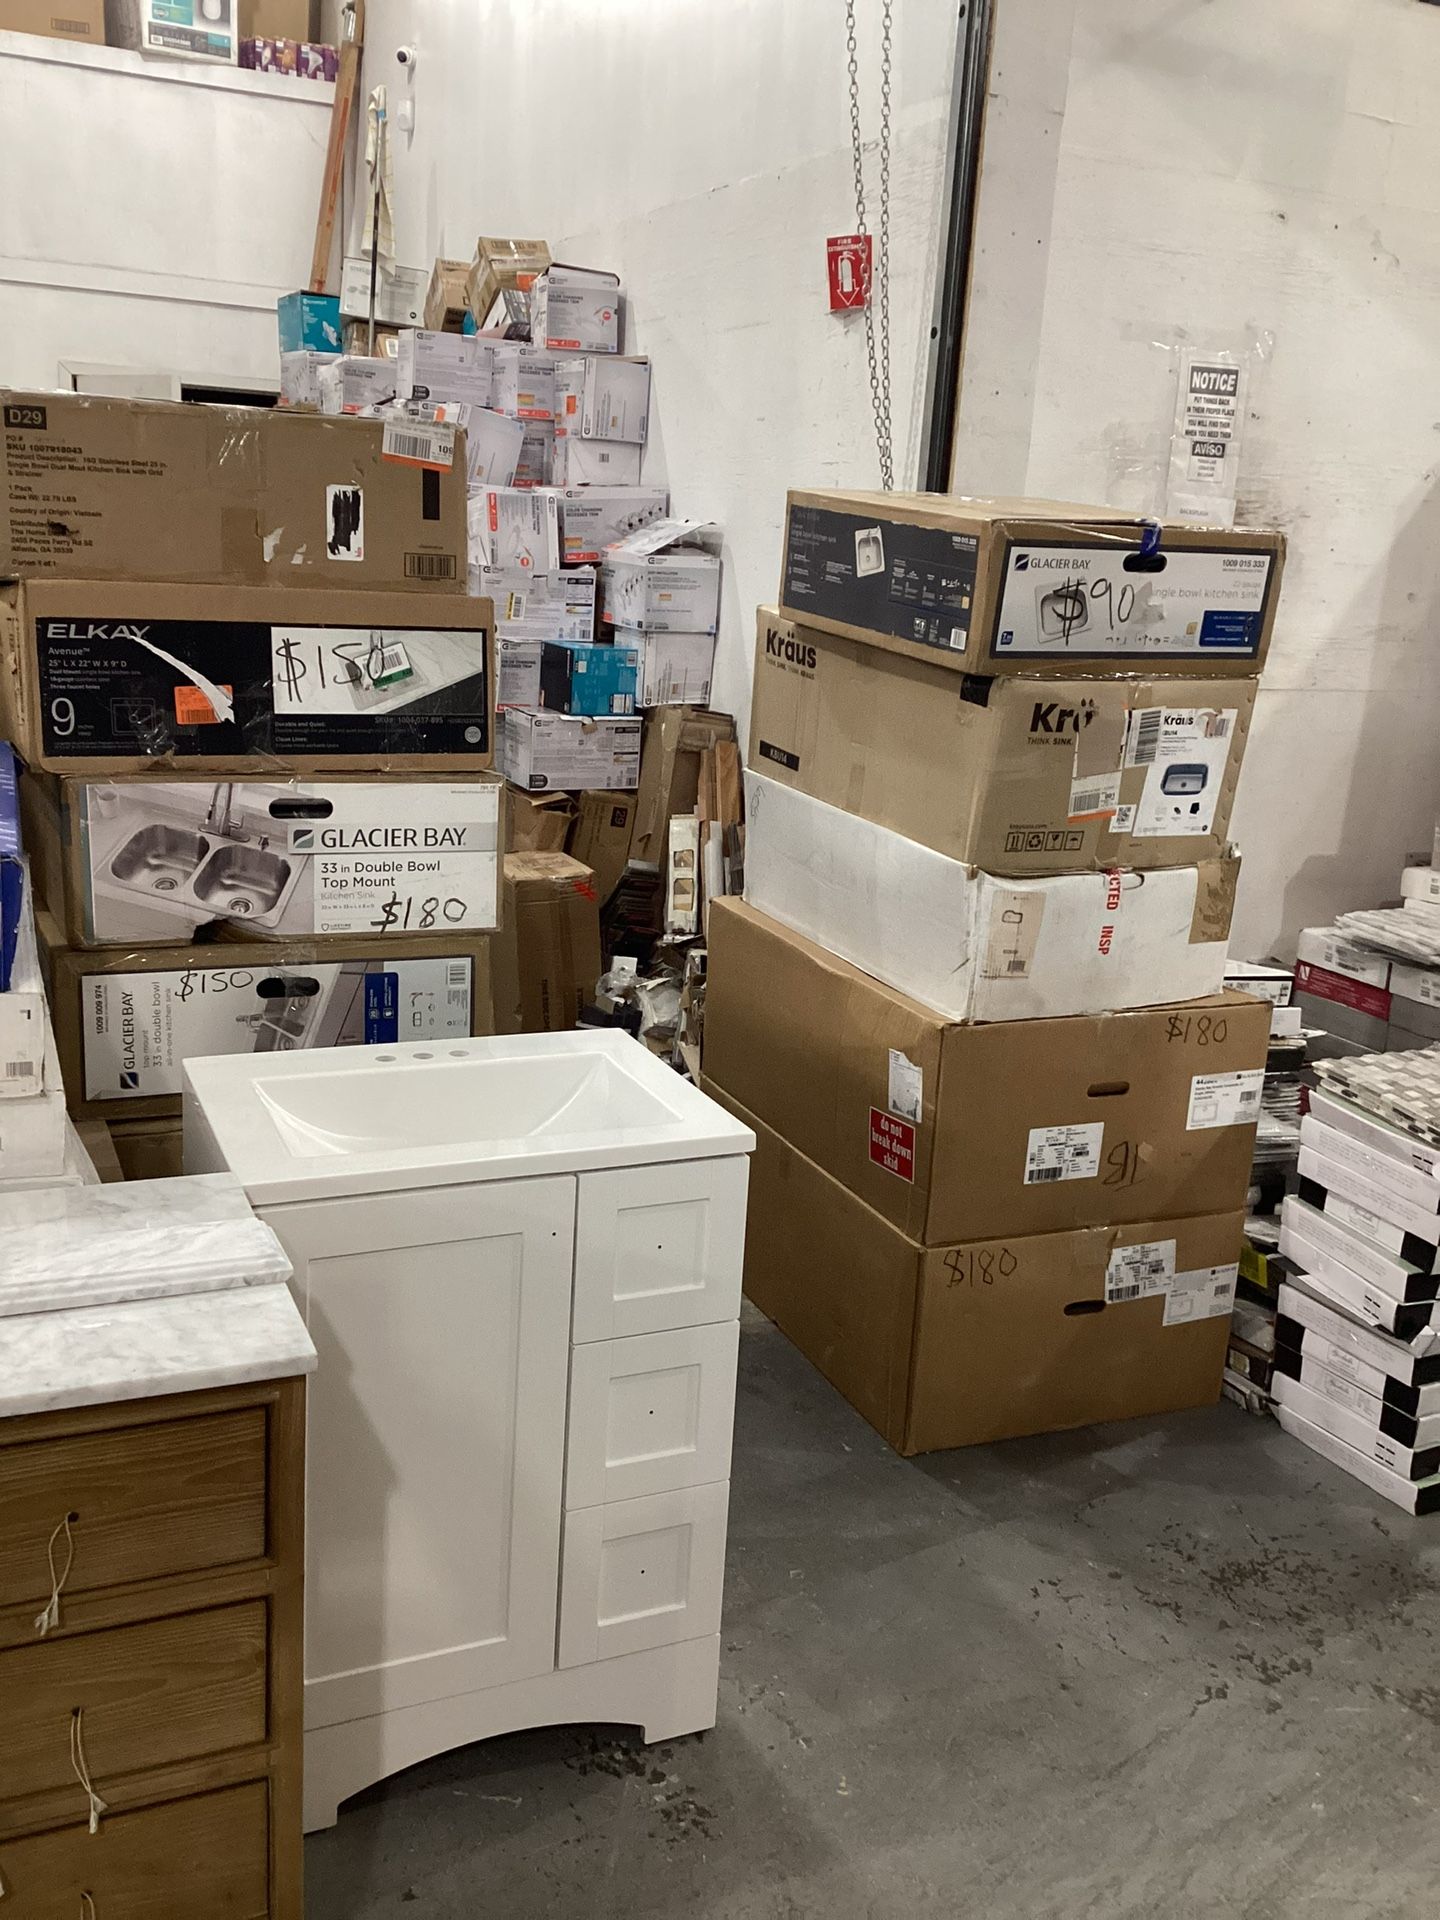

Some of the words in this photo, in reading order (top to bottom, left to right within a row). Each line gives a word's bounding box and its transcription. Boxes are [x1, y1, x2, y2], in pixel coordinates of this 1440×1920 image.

[1192, 371, 1236, 392] NOTICE
[9, 408, 43, 425] D29
[1030, 557, 1070, 569] GLACIER
[1072, 558, 1091, 570] BAY
[1223, 559, 1239, 567] 1009
[1178, 587, 1201, 598] bowl
[1203, 588, 1239, 599] kitchen
[1052, 576, 1135, 646] $90
[47, 623, 151, 640] ELKAY
[766, 628, 817, 669] Kräus
[92, 660, 101, 668] W
[275, 637, 385, 703] $150
[51, 697, 75, 736] 9
[1027, 737, 1051, 745] THINK
[321, 828, 418, 849] GLACIER
[424, 827, 468, 848] BAY
[321, 862, 338, 874] 33
[340, 863, 350, 873] in
[354, 861, 403, 873] Double
[407, 860, 440, 872] Bowl
[321, 877, 349, 890] Top
[353, 876, 396, 888] Mount
[320, 891, 355, 900] Kitchen
[357, 891, 376, 899] Sink
[370, 890, 468, 934] $180
[1098, 925, 1114, 955] INSP
[95, 984, 103, 1000] 974
[151, 981, 161, 1007] bowl
[174, 970, 254, 1002] $150
[95, 1000, 103, 1015] 009
[121, 991, 134, 1016] BAY
[96, 1016, 104, 1035] 1009
[152, 1009, 162, 1044] double
[165, 1003, 173, 1031] kitchen
[1165, 1012, 1228, 1046] $180
[122, 1018, 136, 1070] GLACIER
[141, 1029, 149, 1054] mount
[142, 1055, 150, 1069] top
[153, 1055, 162, 1067] 33
[881, 1115, 889, 1132] do
[890, 1123, 902, 1139] not
[871, 1127, 891, 1150] break
[892, 1138, 912, 1161] down
[883, 1152, 898, 1171] skid
